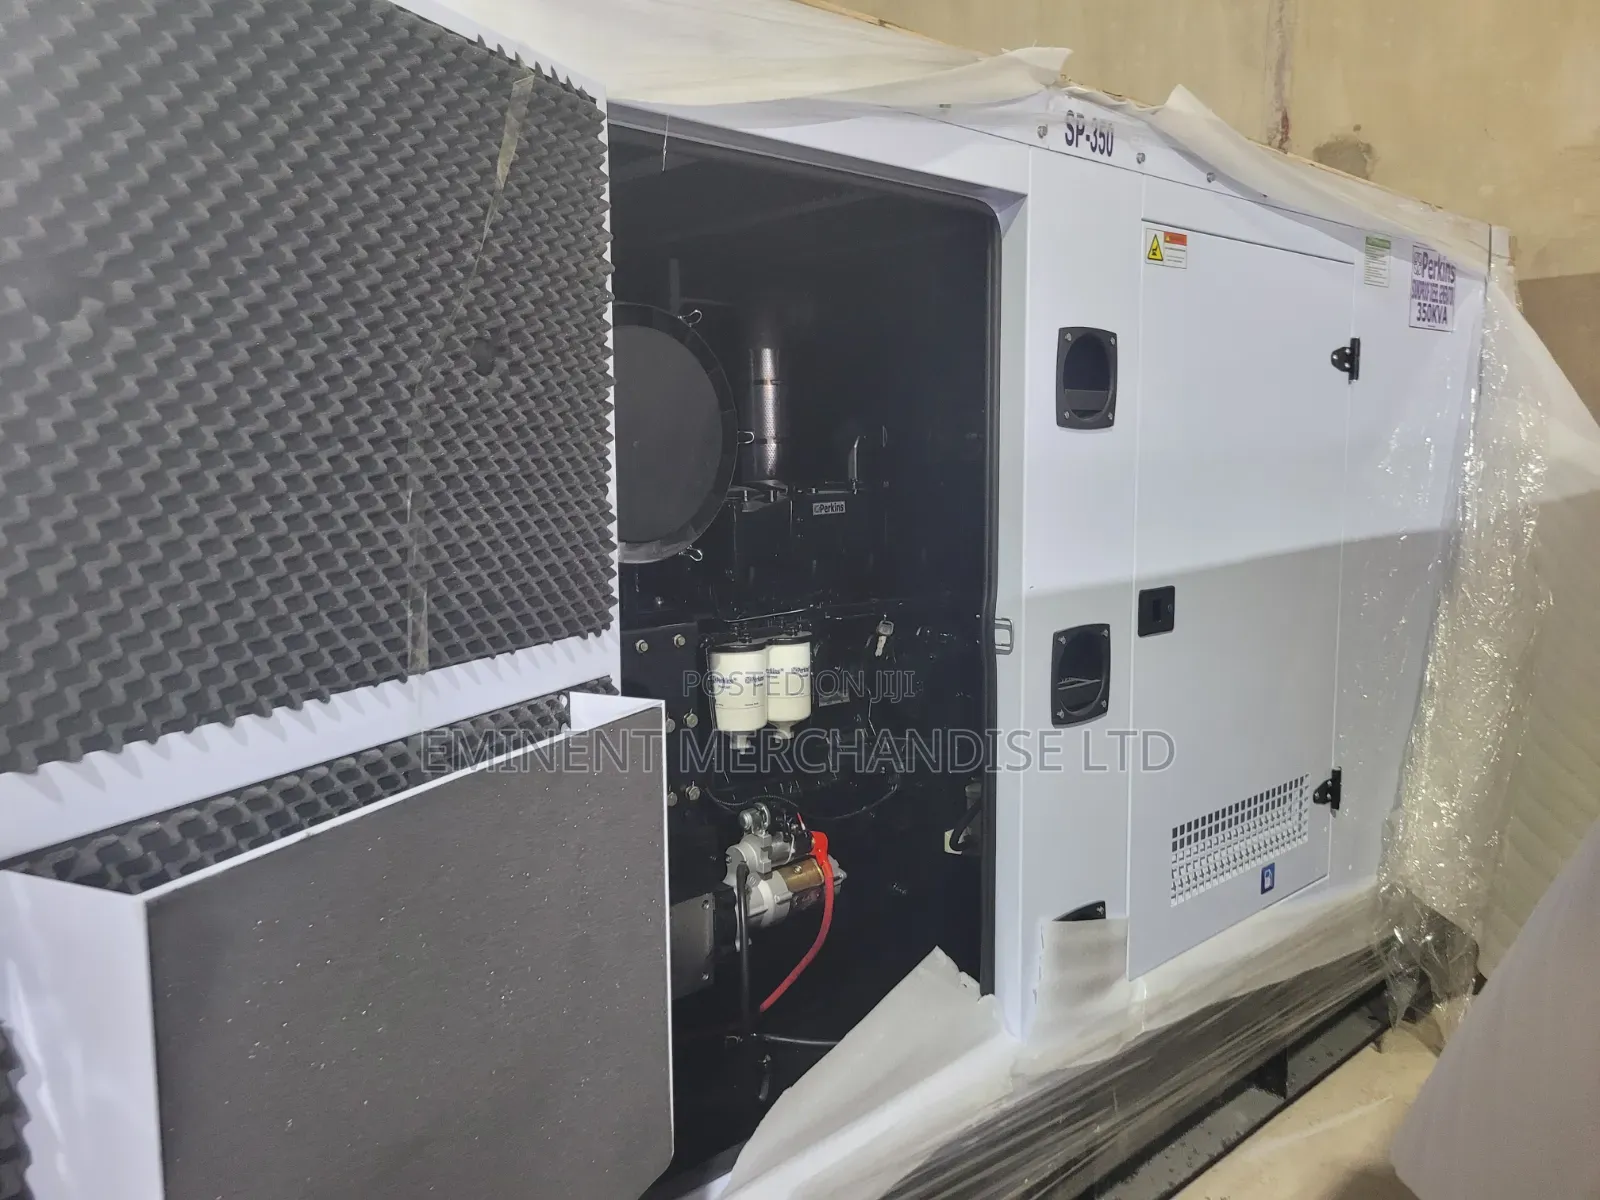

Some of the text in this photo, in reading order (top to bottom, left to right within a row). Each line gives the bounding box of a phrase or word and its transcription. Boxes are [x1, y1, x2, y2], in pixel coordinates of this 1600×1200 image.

[1064, 110, 1114, 157] SP-350
[1422, 252, 1456, 284] Perkins
[1416, 302, 1448, 324] 350KVA
[819, 502, 844, 513] Perkins
